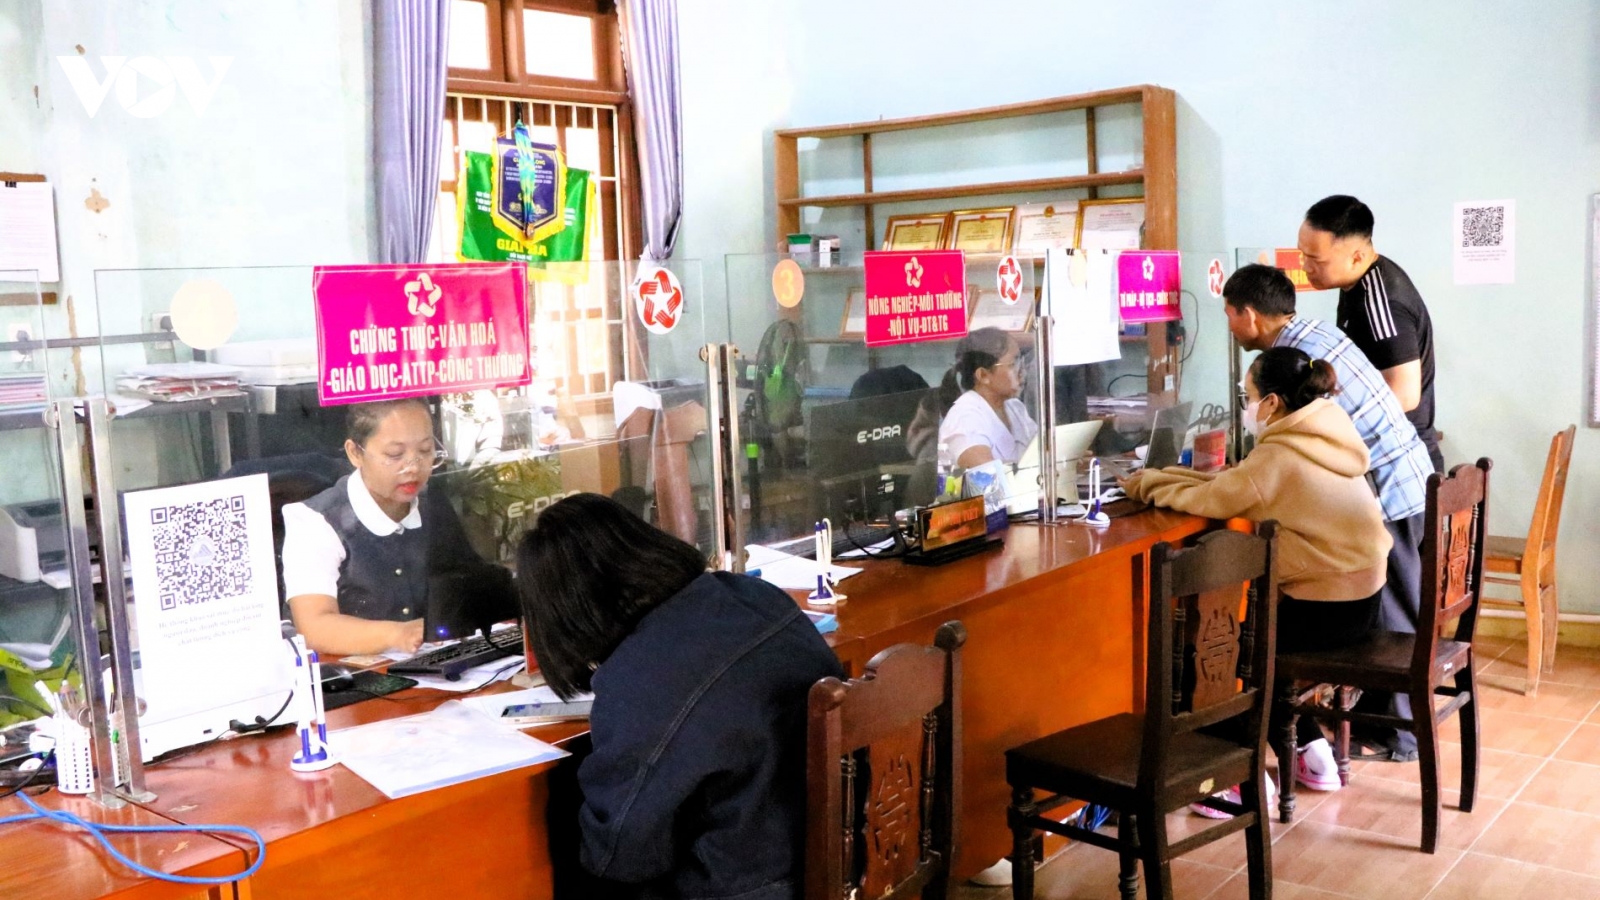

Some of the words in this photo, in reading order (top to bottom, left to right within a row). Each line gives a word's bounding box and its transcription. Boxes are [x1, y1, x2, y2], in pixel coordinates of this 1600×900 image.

[780, 268, 795, 300] 3
[868, 295, 890, 316] NÔNG
[350, 324, 397, 355] CHỨNG
[401, 320, 467, 354] THỰC-VĂN
[470, 317, 496, 346] HOÁ
[477, 353, 525, 379] THƯƠNG
[857, 424, 901, 443] E-DRA
